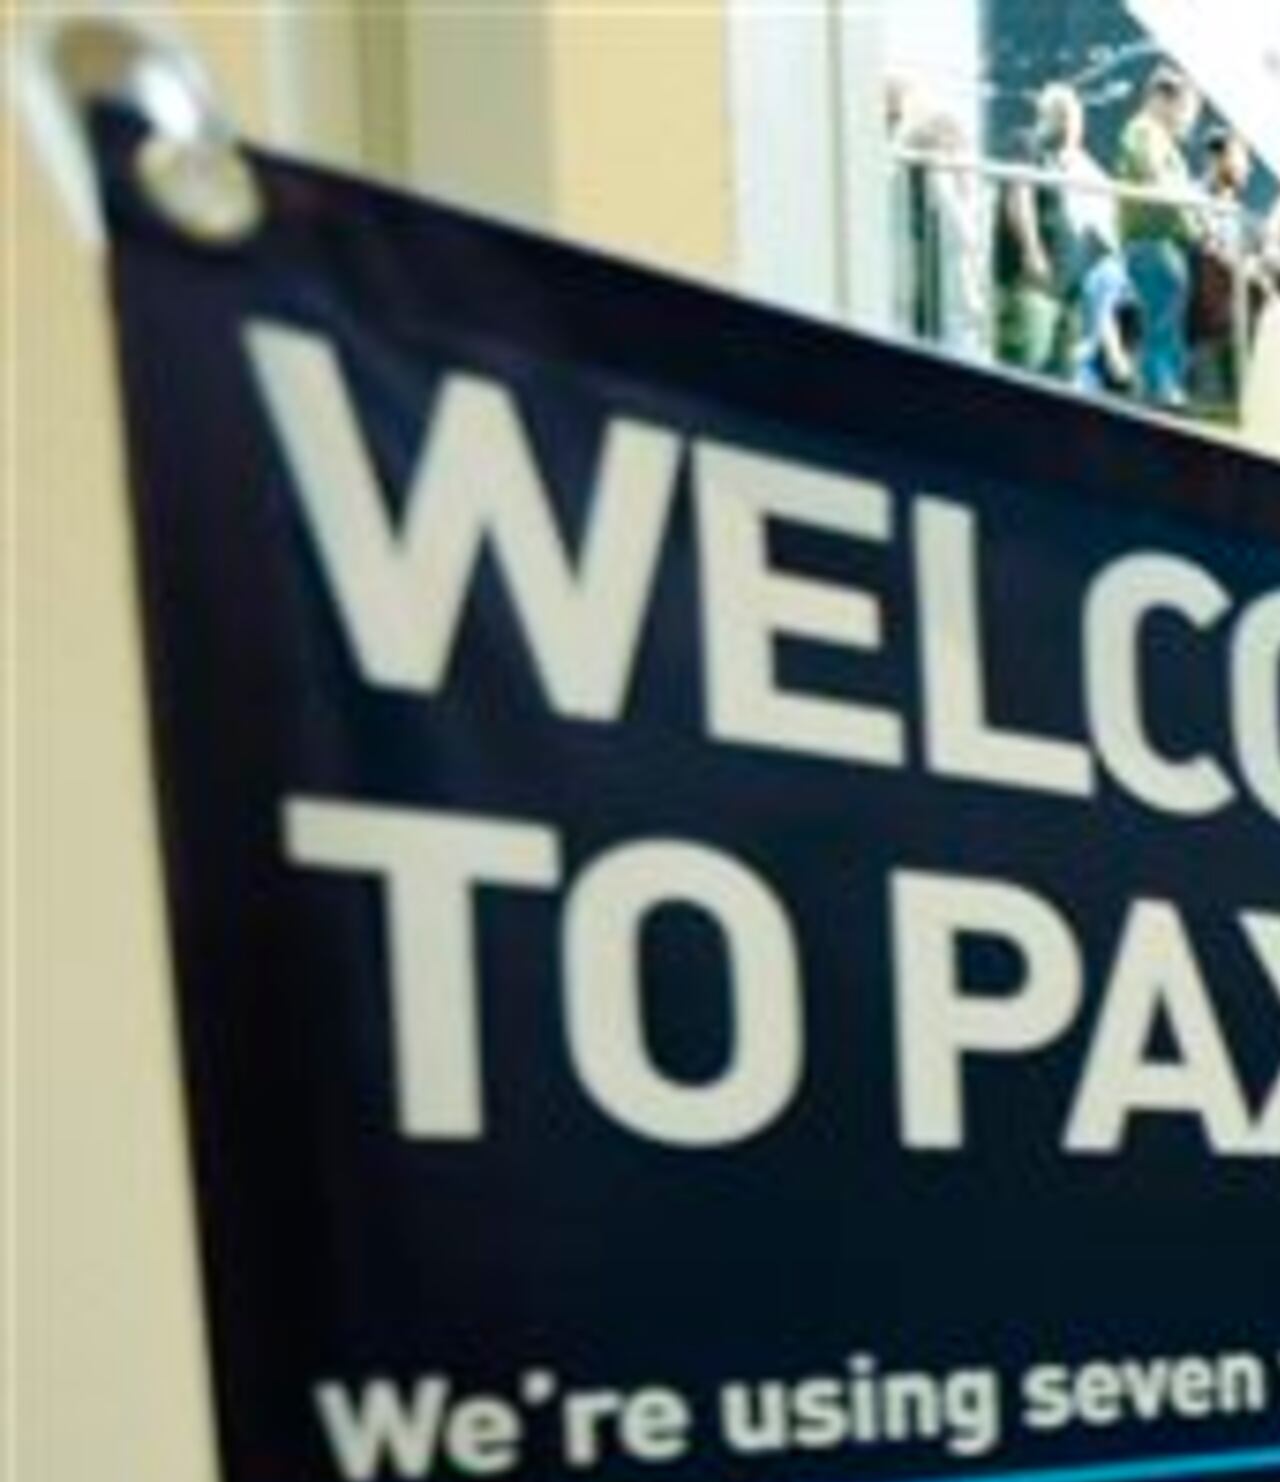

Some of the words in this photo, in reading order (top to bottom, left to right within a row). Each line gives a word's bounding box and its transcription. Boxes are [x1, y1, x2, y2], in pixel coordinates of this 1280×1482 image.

[283, 797, 805, 1150] TO
[729, 1352, 996, 1457] using
[1022, 1329, 1265, 1422] seven
